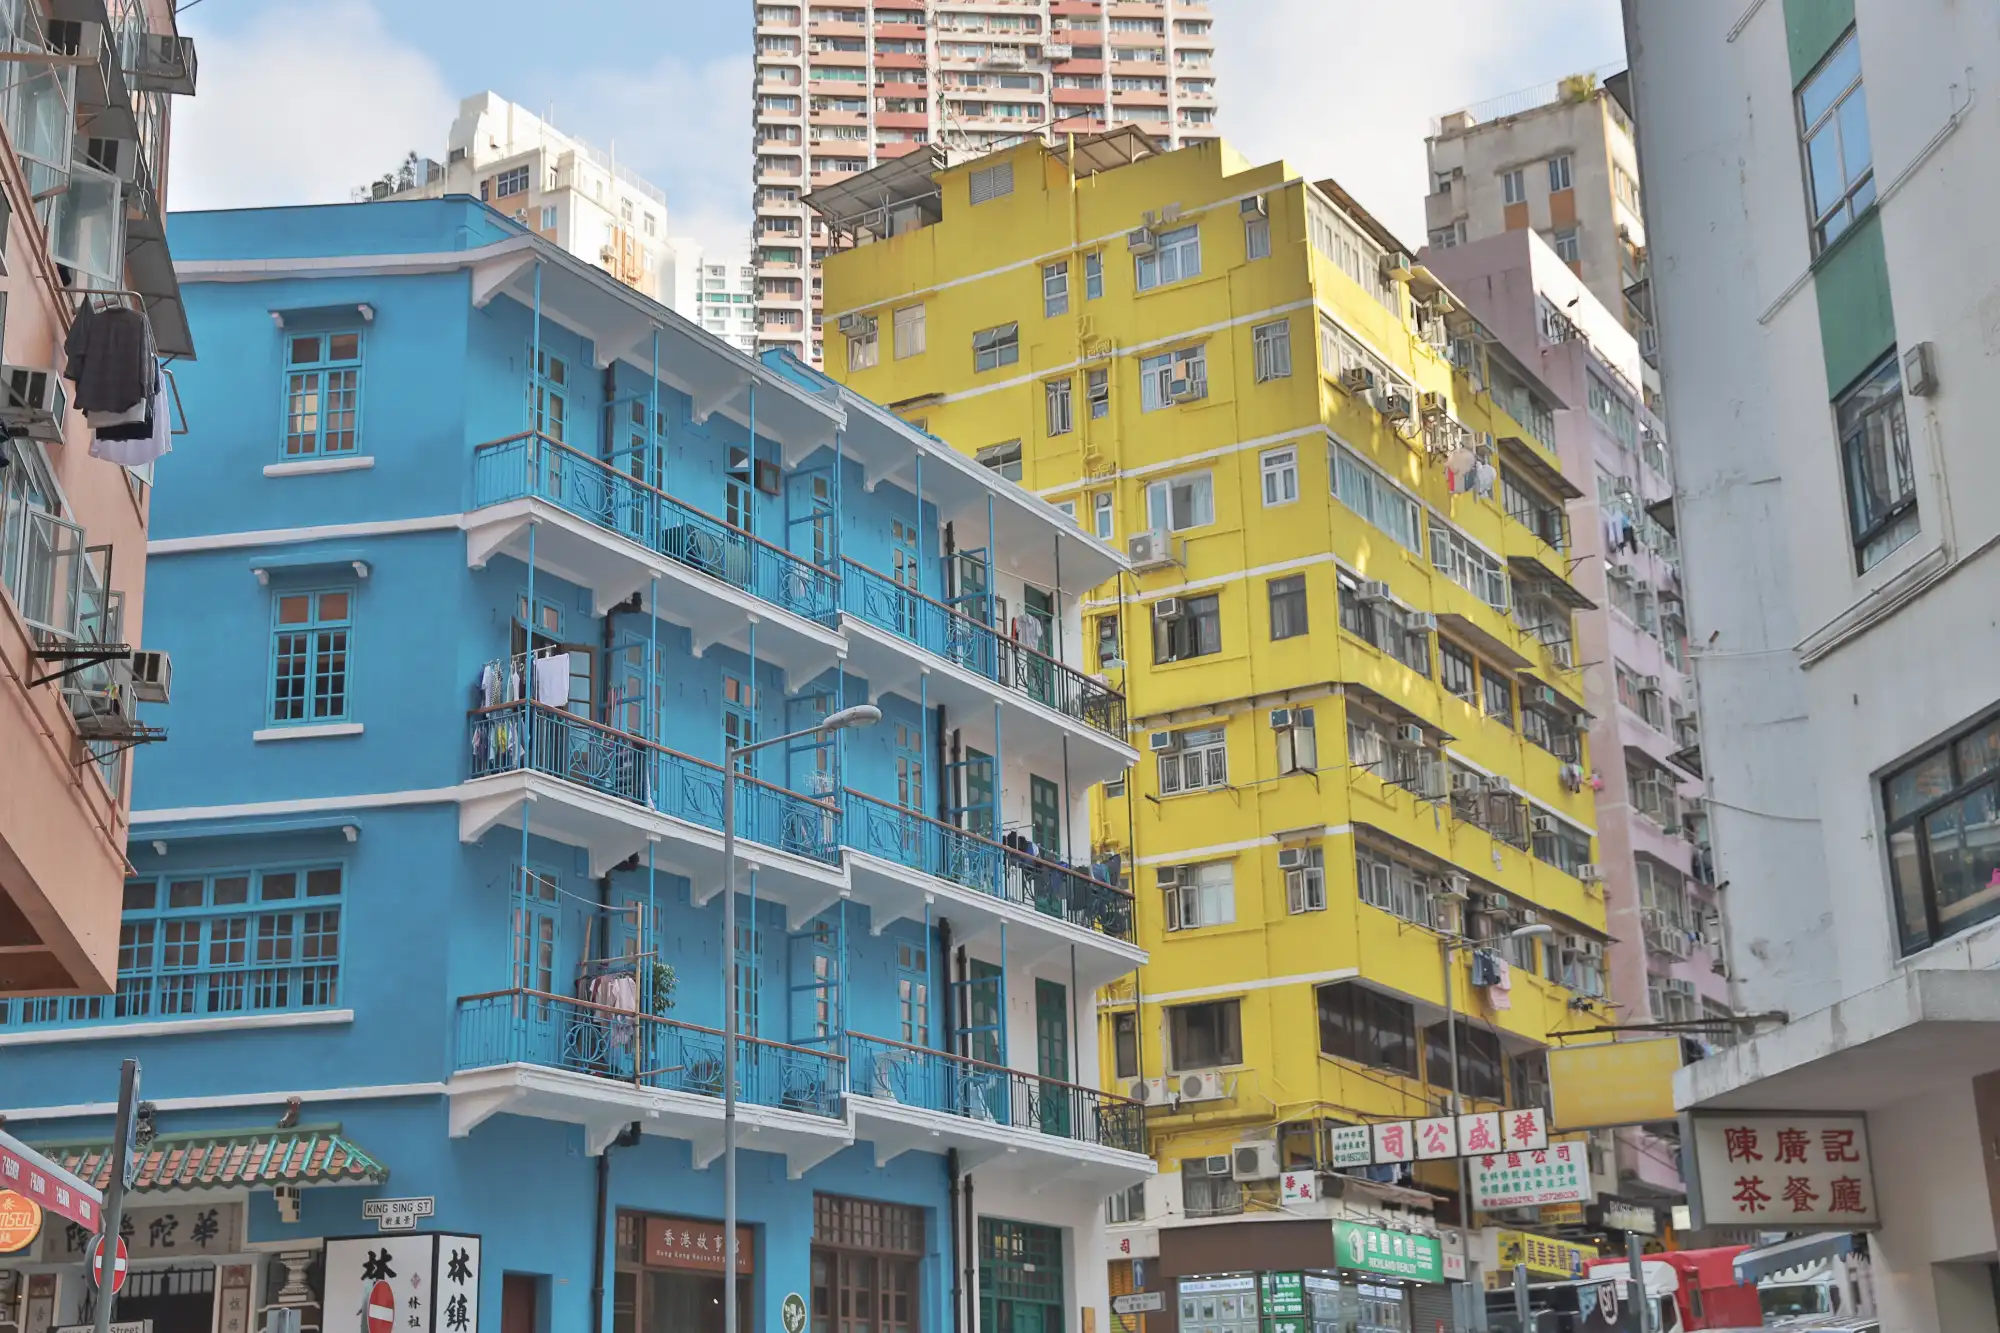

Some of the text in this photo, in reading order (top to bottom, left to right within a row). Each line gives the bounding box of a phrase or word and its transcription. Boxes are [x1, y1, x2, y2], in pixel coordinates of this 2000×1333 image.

[1724, 1126, 1860, 1164] 陳廣記
[367, 1201, 429, 1214] KING SING ST
[1732, 1175, 1868, 1214] 茶餐廳
